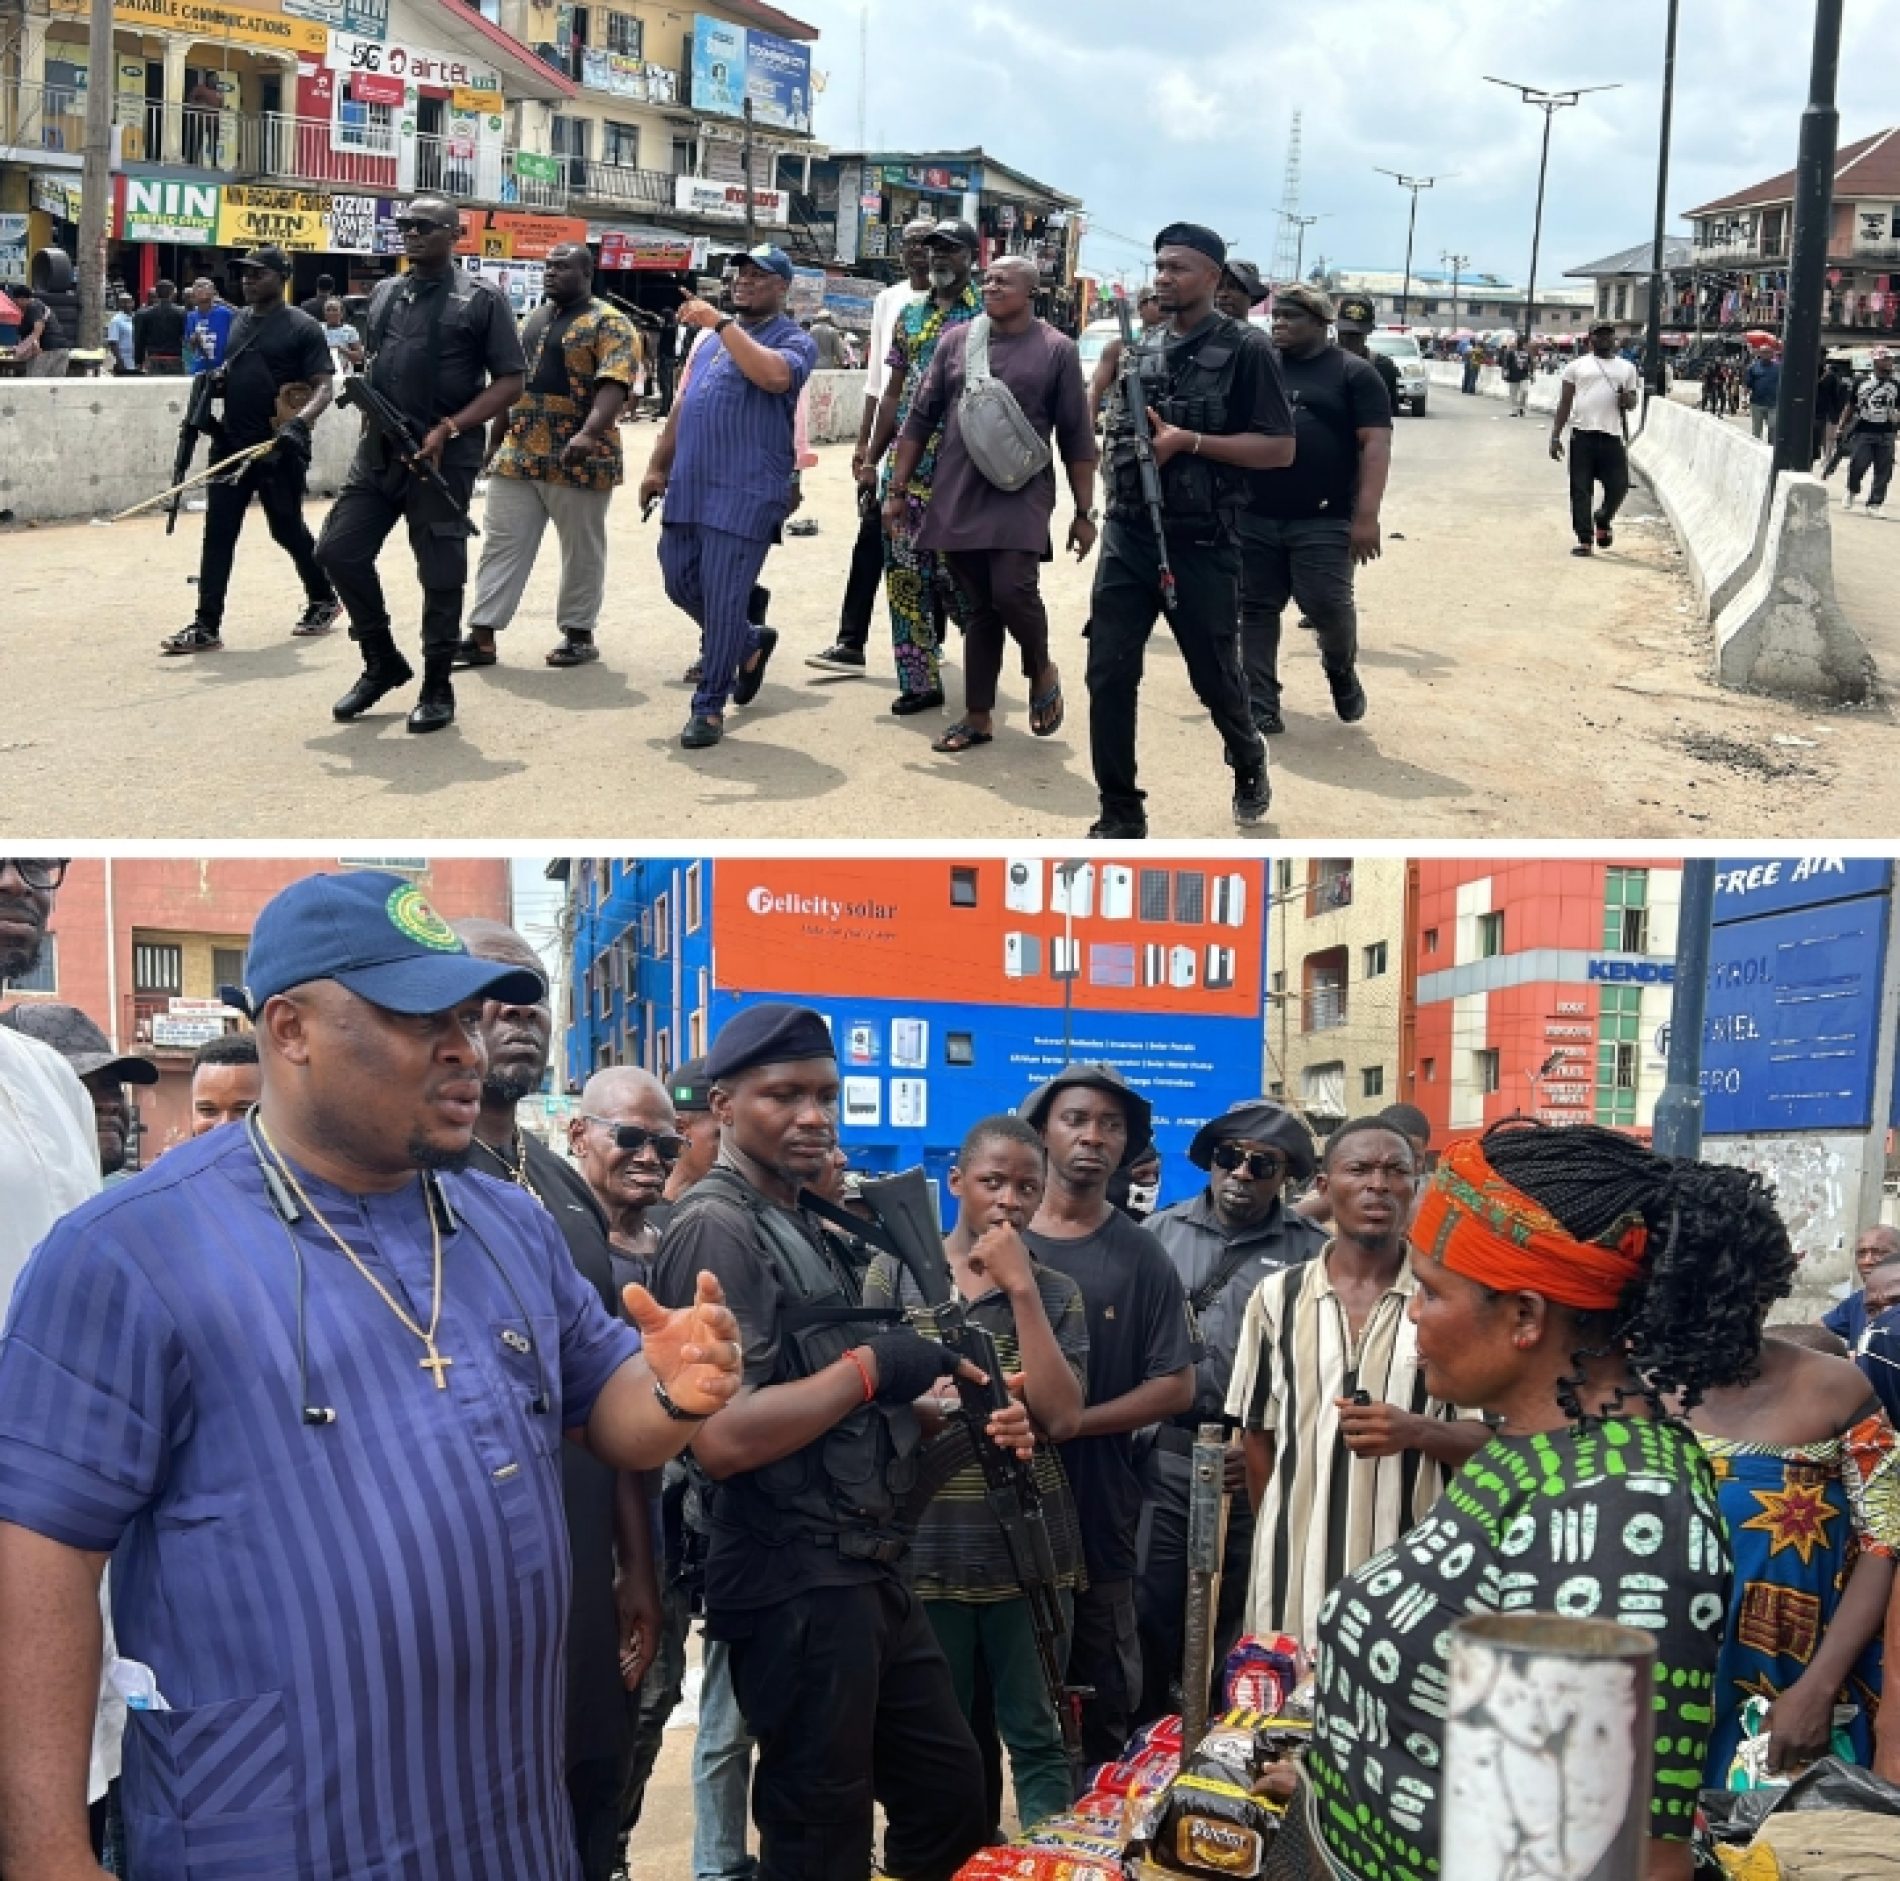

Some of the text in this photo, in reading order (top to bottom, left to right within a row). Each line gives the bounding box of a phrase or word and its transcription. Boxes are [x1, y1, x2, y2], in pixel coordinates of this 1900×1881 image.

[351, 42, 383, 71] 5G
[411, 57, 470, 85] airtel
[128, 181, 217, 217] NIN
[247, 211, 304, 230] MTN
[1714, 862, 1782, 895] FREE
[747, 885, 897, 921] Felicity solar
[1707, 956, 1773, 990] TROL
[1705, 1015, 1760, 1042] SIEL
[1699, 1068, 1740, 1095] ERO
